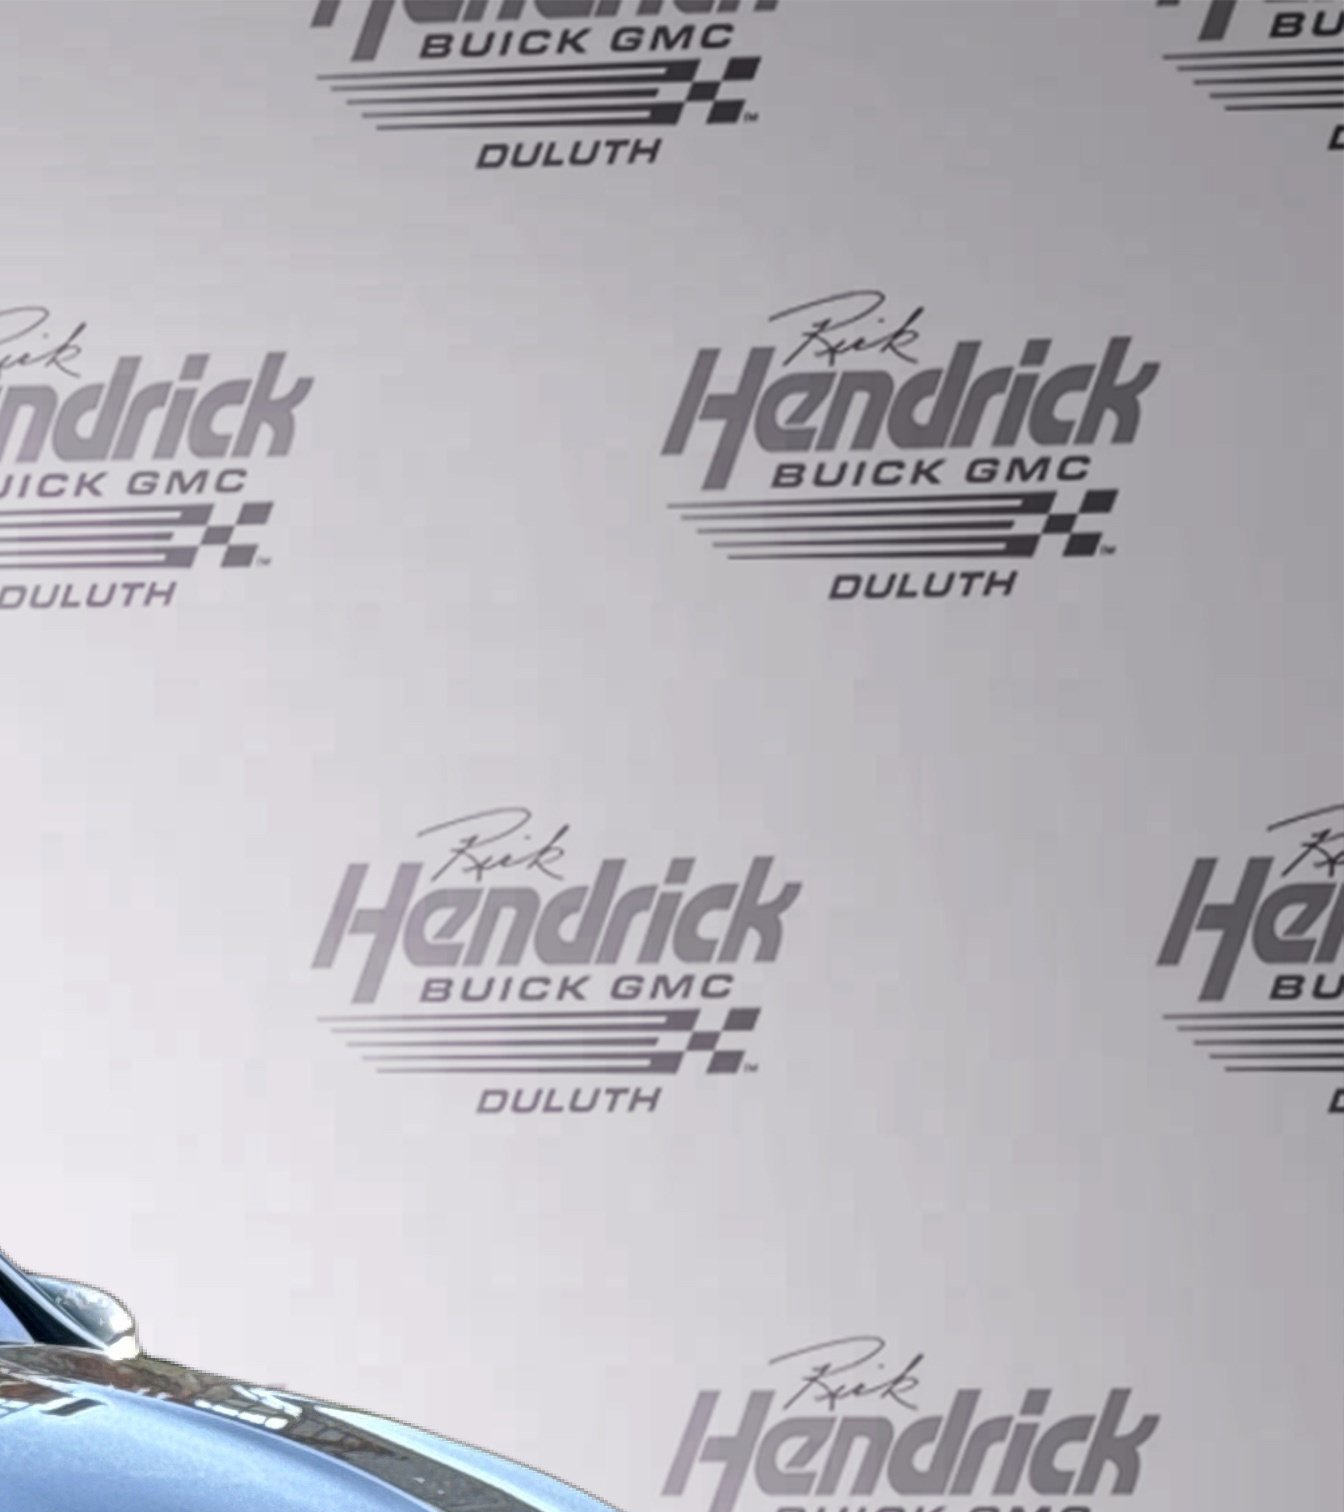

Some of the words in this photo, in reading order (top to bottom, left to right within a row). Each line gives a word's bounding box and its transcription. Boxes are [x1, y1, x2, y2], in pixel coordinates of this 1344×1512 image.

[419, 28, 591, 59] BUICK
[610, 23, 734, 52] GMC
[476, 138, 662, 169] DULUTH
[662, 335, 1160, 490] Hendrick
[126, 468, 247, 495] GMC
[771, 459, 945, 488] BUICK
[965, 455, 1091, 483] GMC
[829, 570, 1018, 600] DULUTH
[312, 856, 802, 1003] Hendrick
[420, 975, 590, 1002] BUICK
[610, 974, 734, 1000] GMC
[477, 1087, 662, 1114] DULUTH
